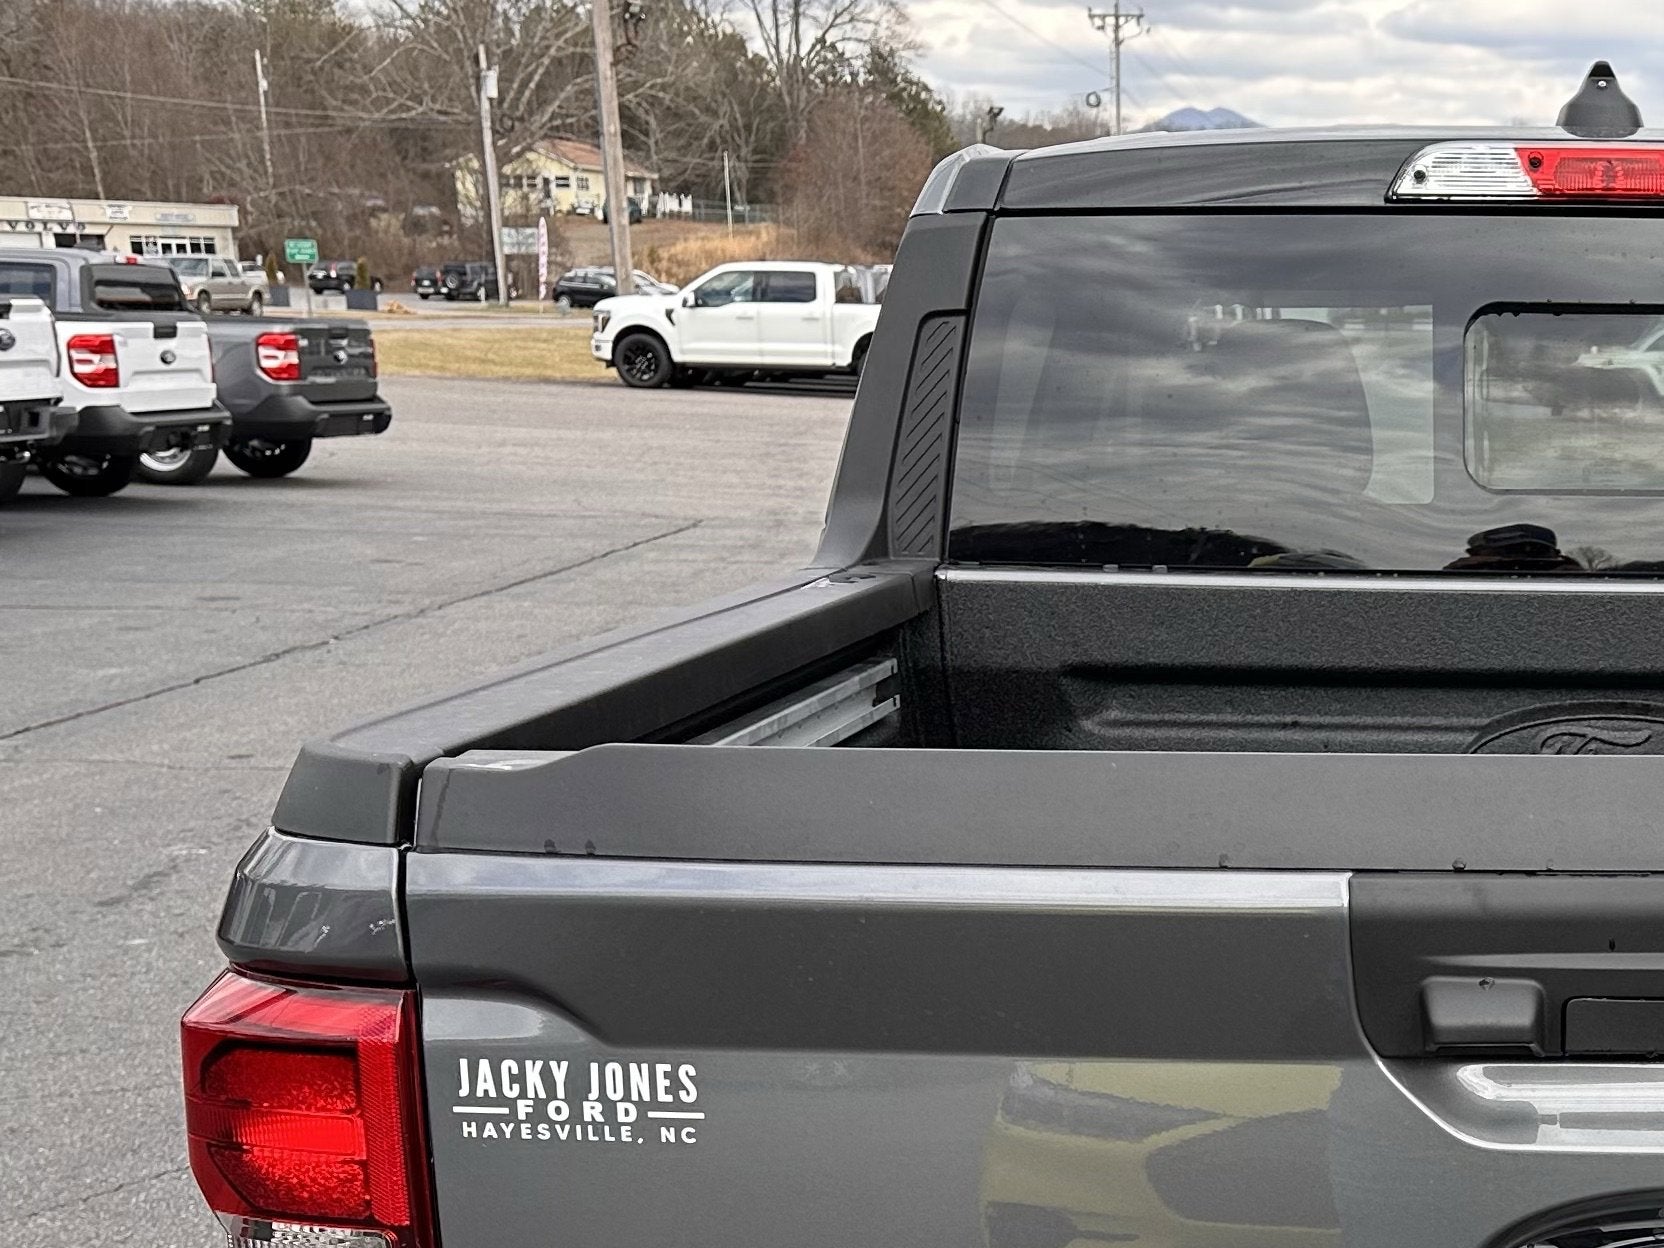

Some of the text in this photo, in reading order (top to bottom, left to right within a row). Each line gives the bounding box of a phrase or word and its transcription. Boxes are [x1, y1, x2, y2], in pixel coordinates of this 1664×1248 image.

[6, 219, 87, 232] VOLVO
[458, 1058, 698, 1103] JACKY JONES
[516, 1099, 638, 1123] FORD
[462, 1121, 697, 1144] HAYESVILLE, NC
